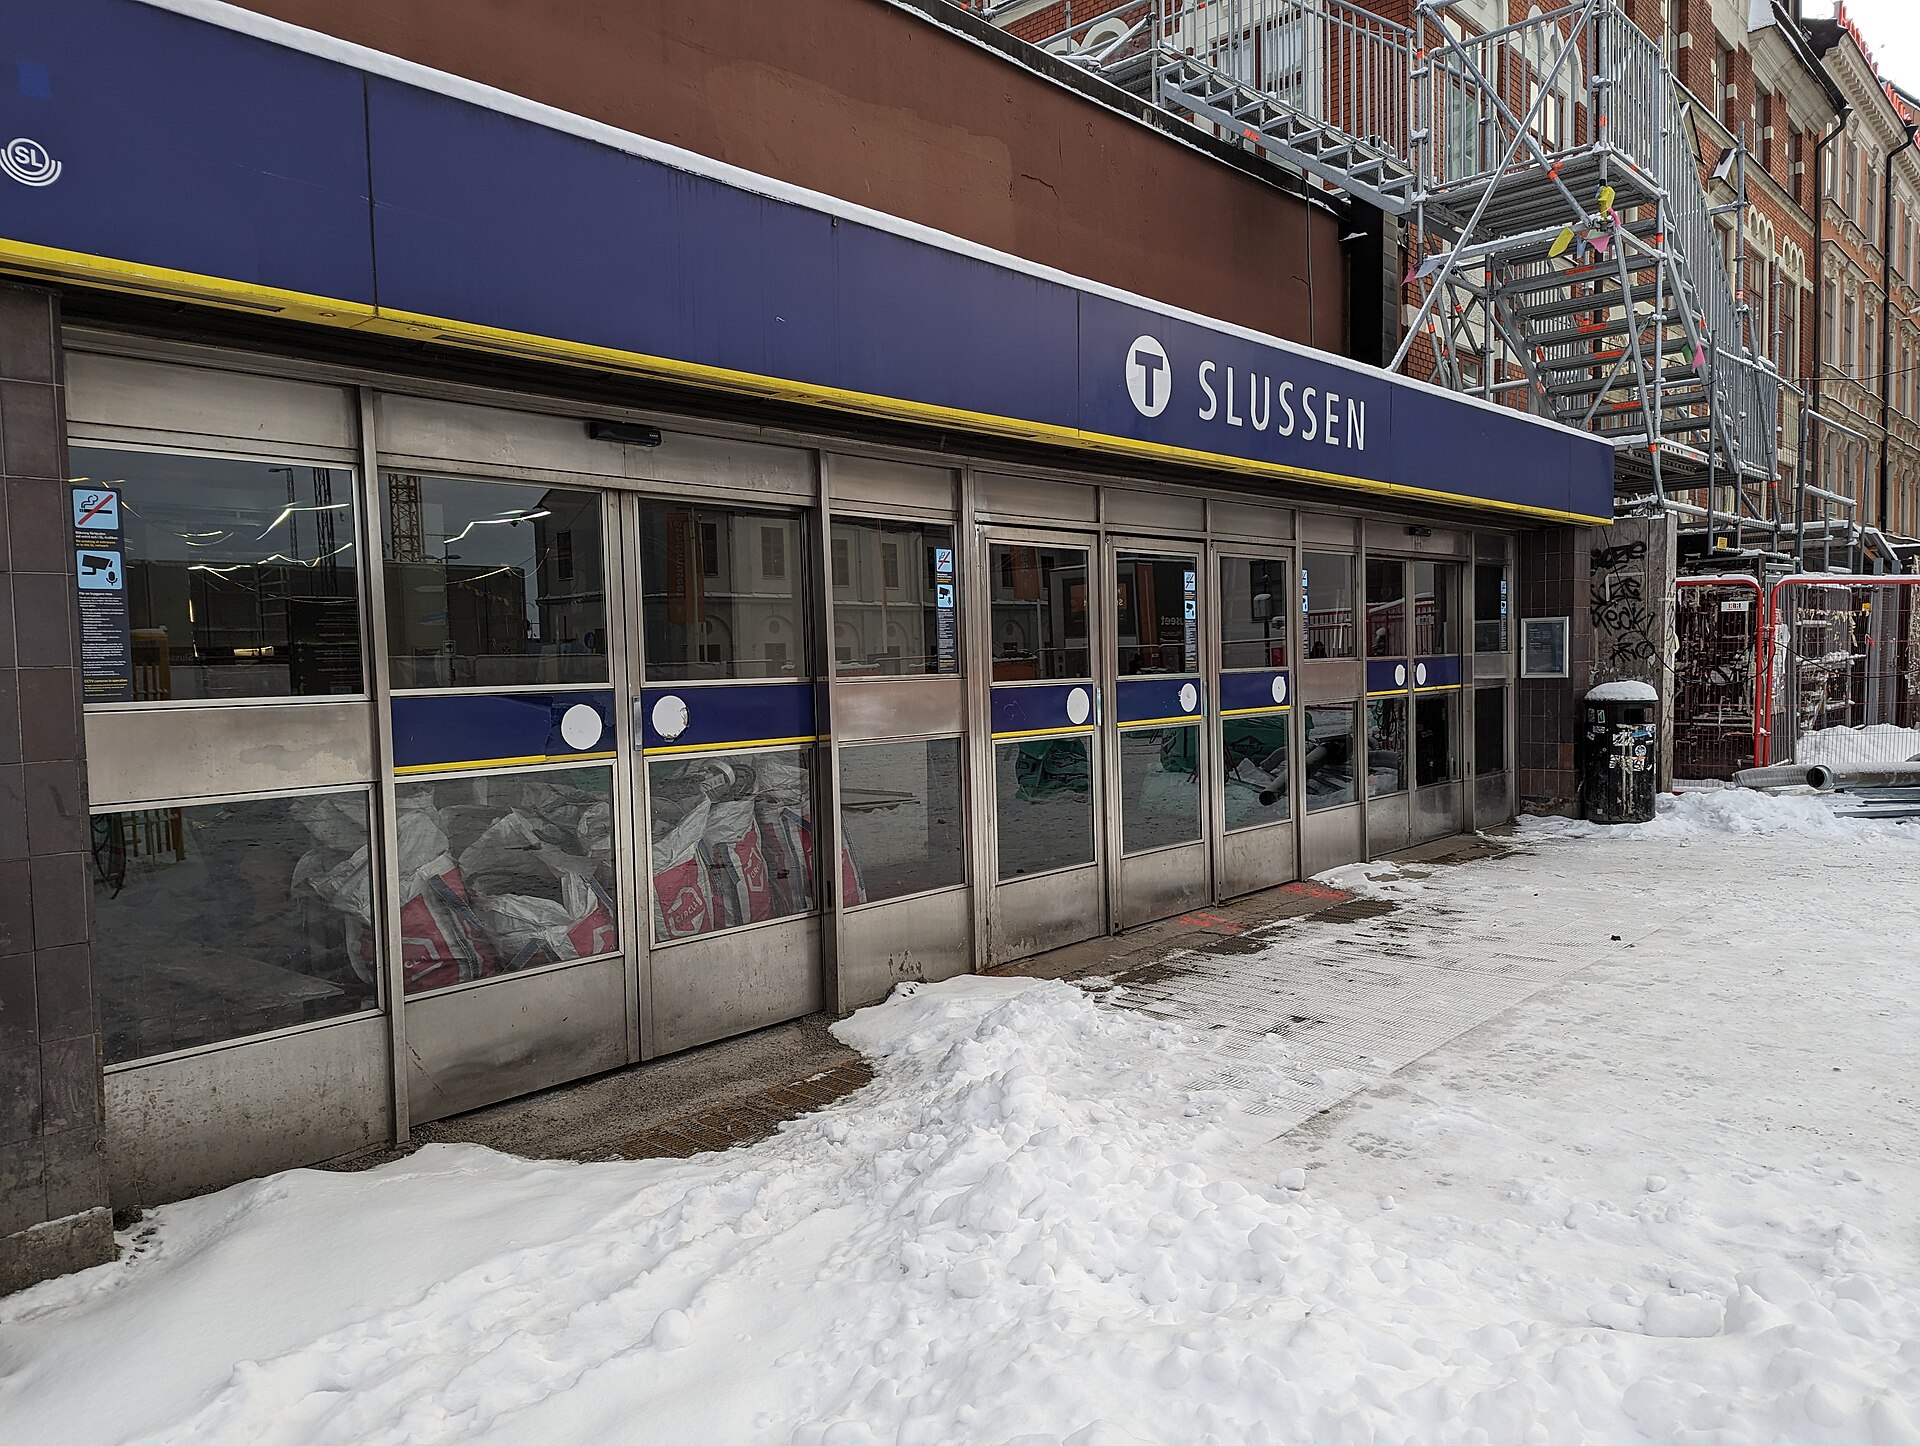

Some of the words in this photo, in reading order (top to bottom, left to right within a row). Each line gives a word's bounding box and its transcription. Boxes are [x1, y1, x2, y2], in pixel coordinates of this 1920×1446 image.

[15, 146, 43, 168] SL
[1135, 350, 1163, 407] T
[1198, 360, 1365, 451] SLUSSEN
